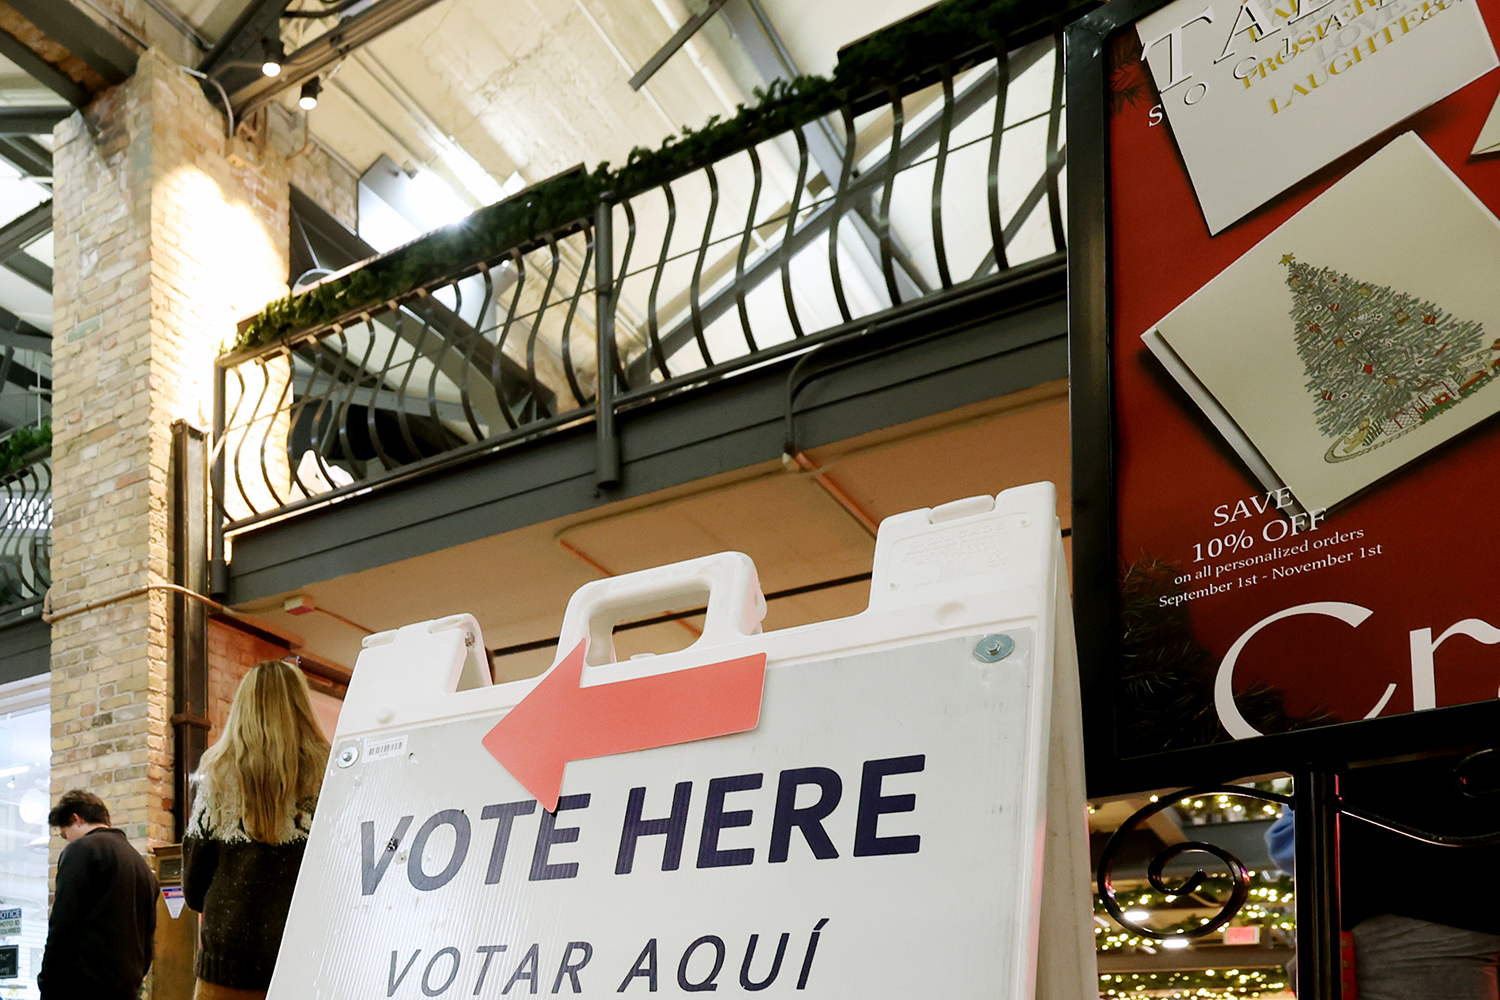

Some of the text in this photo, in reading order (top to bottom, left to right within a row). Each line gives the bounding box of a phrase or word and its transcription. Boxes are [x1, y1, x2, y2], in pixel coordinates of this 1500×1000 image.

[1192, 507, 1327, 564] 10% OFF
[1213, 486, 1294, 527] SAVE
[1159, 579, 1233, 608] September
[1237, 574, 1258, 589] 1st
[1272, 550, 1353, 580] November
[1360, 544, 1383, 559] 1st
[1174, 527, 1365, 585] on all personalized orders
[359, 754, 926, 897] VOTE HERE
[387, 917, 830, 998] VOTAR AQUÍ
